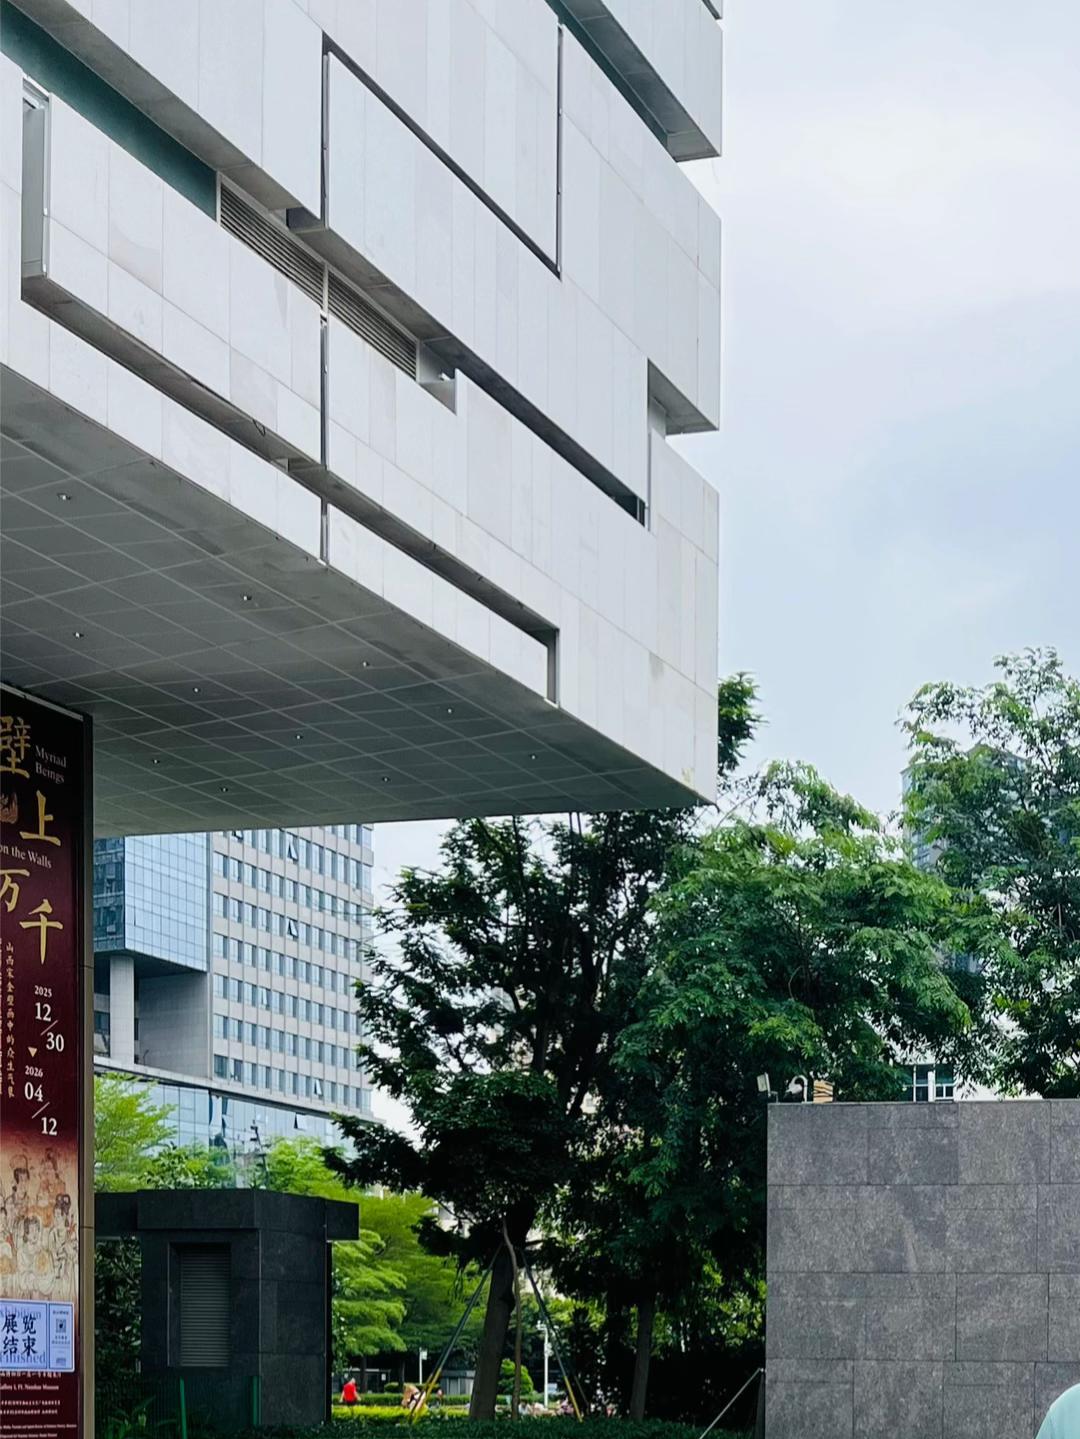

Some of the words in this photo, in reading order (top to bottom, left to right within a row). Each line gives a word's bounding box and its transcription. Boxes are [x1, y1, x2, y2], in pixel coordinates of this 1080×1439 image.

[35, 745, 67, 769] Myriad
[35, 762, 65, 784] Beings
[20, 790, 61, 847] 上
[11, 846, 26, 860] the
[27, 850, 52, 869] Walls
[0, 869, 30, 913] 万
[20, 899, 63, 966] 千
[34, 985, 52, 998] 2025
[25, 1065, 43, 1078] 2026
[2, 1313, 38, 1335] 展览
[2, 1335, 38, 1357] 结束
